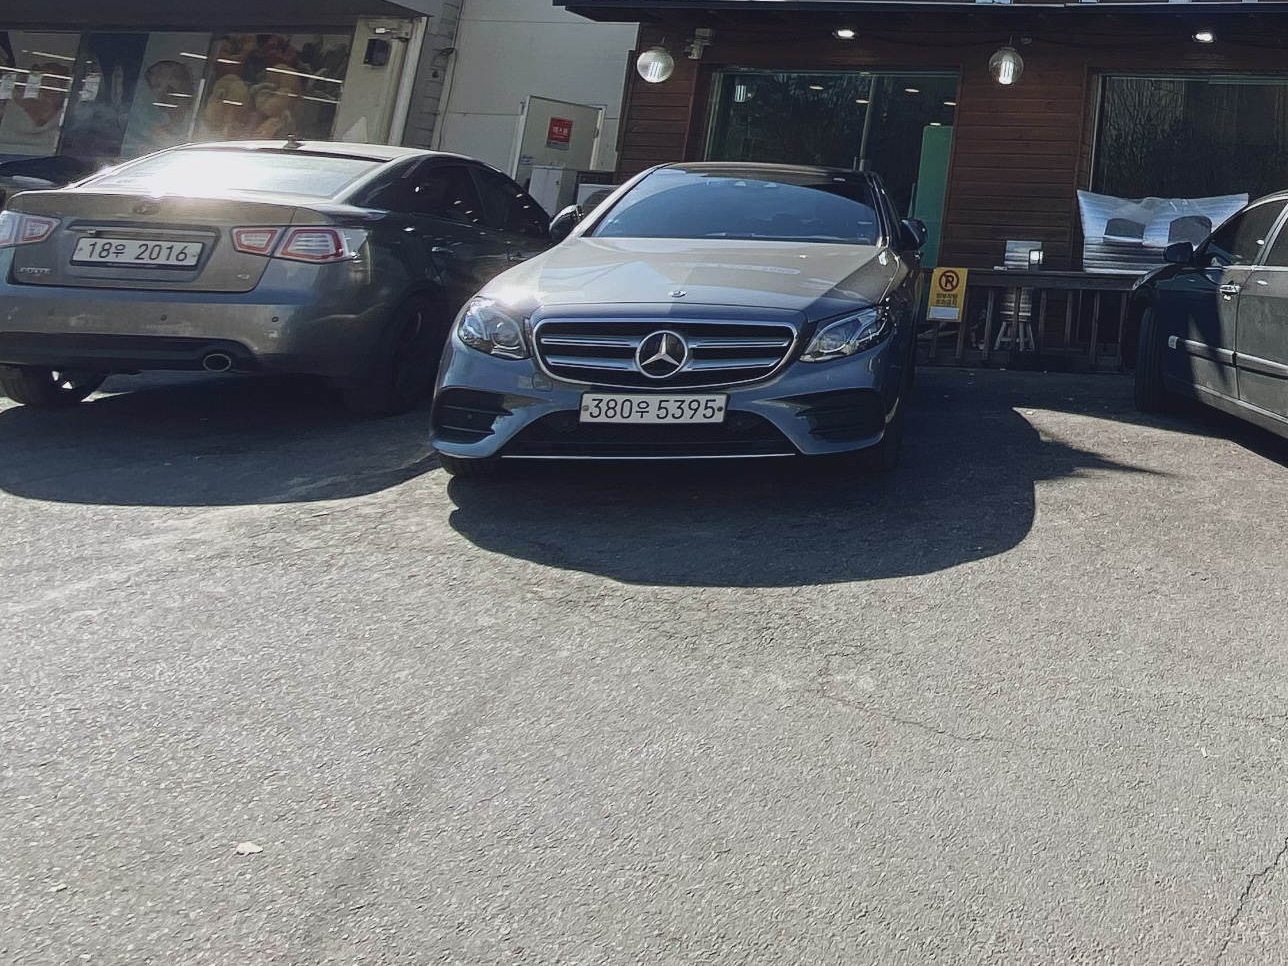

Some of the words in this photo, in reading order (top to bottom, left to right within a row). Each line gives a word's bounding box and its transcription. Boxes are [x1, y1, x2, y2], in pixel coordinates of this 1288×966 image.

[86, 241, 126, 260] 18우
[134, 243, 188, 262] 2016
[589, 398, 650, 419] 380우
[656, 399, 717, 420] 5395
